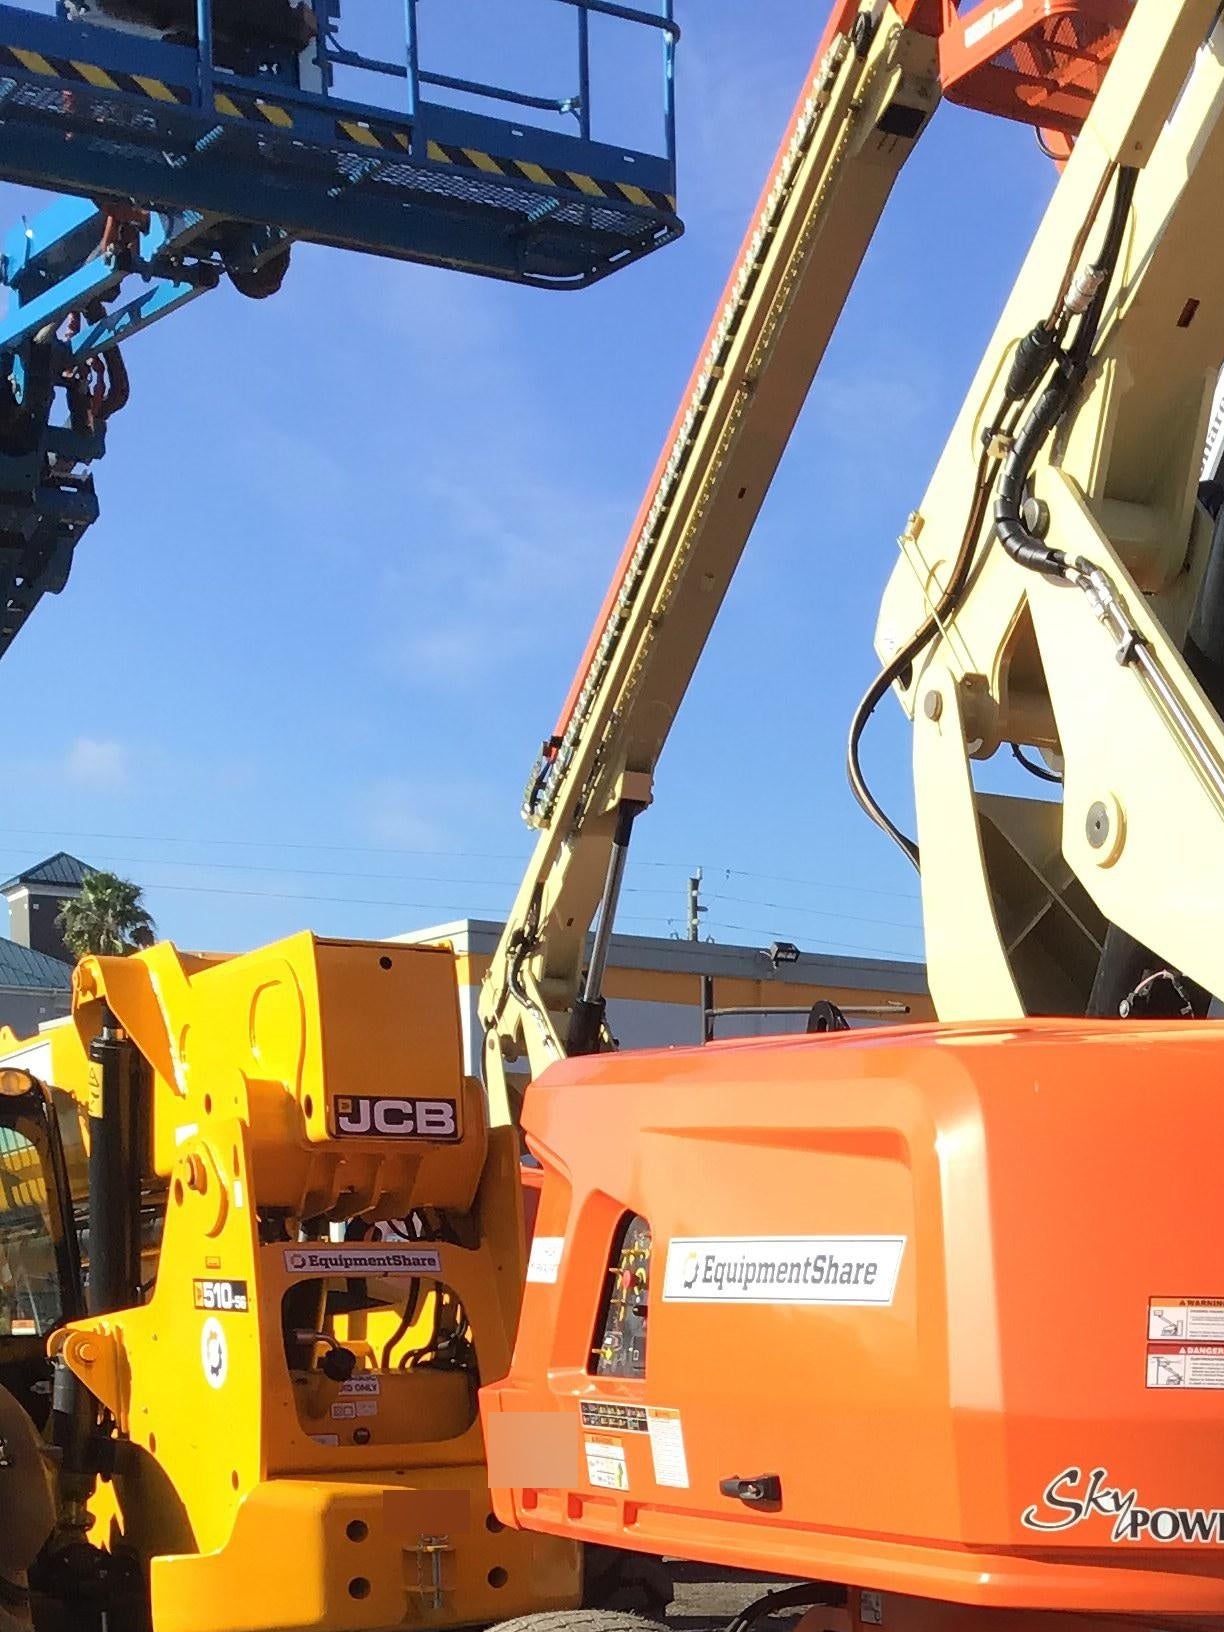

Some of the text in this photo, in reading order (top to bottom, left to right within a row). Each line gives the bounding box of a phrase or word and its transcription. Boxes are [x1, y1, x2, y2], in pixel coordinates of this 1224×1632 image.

[339, 1099, 455, 1134] JCB
[308, 1254, 437, 1269] EquipmentShare
[702, 1254, 878, 1291] EquipmentShare
[1187, 1346, 1224, 1355] DANGER
[1024, 1468, 1137, 1541] Sky
